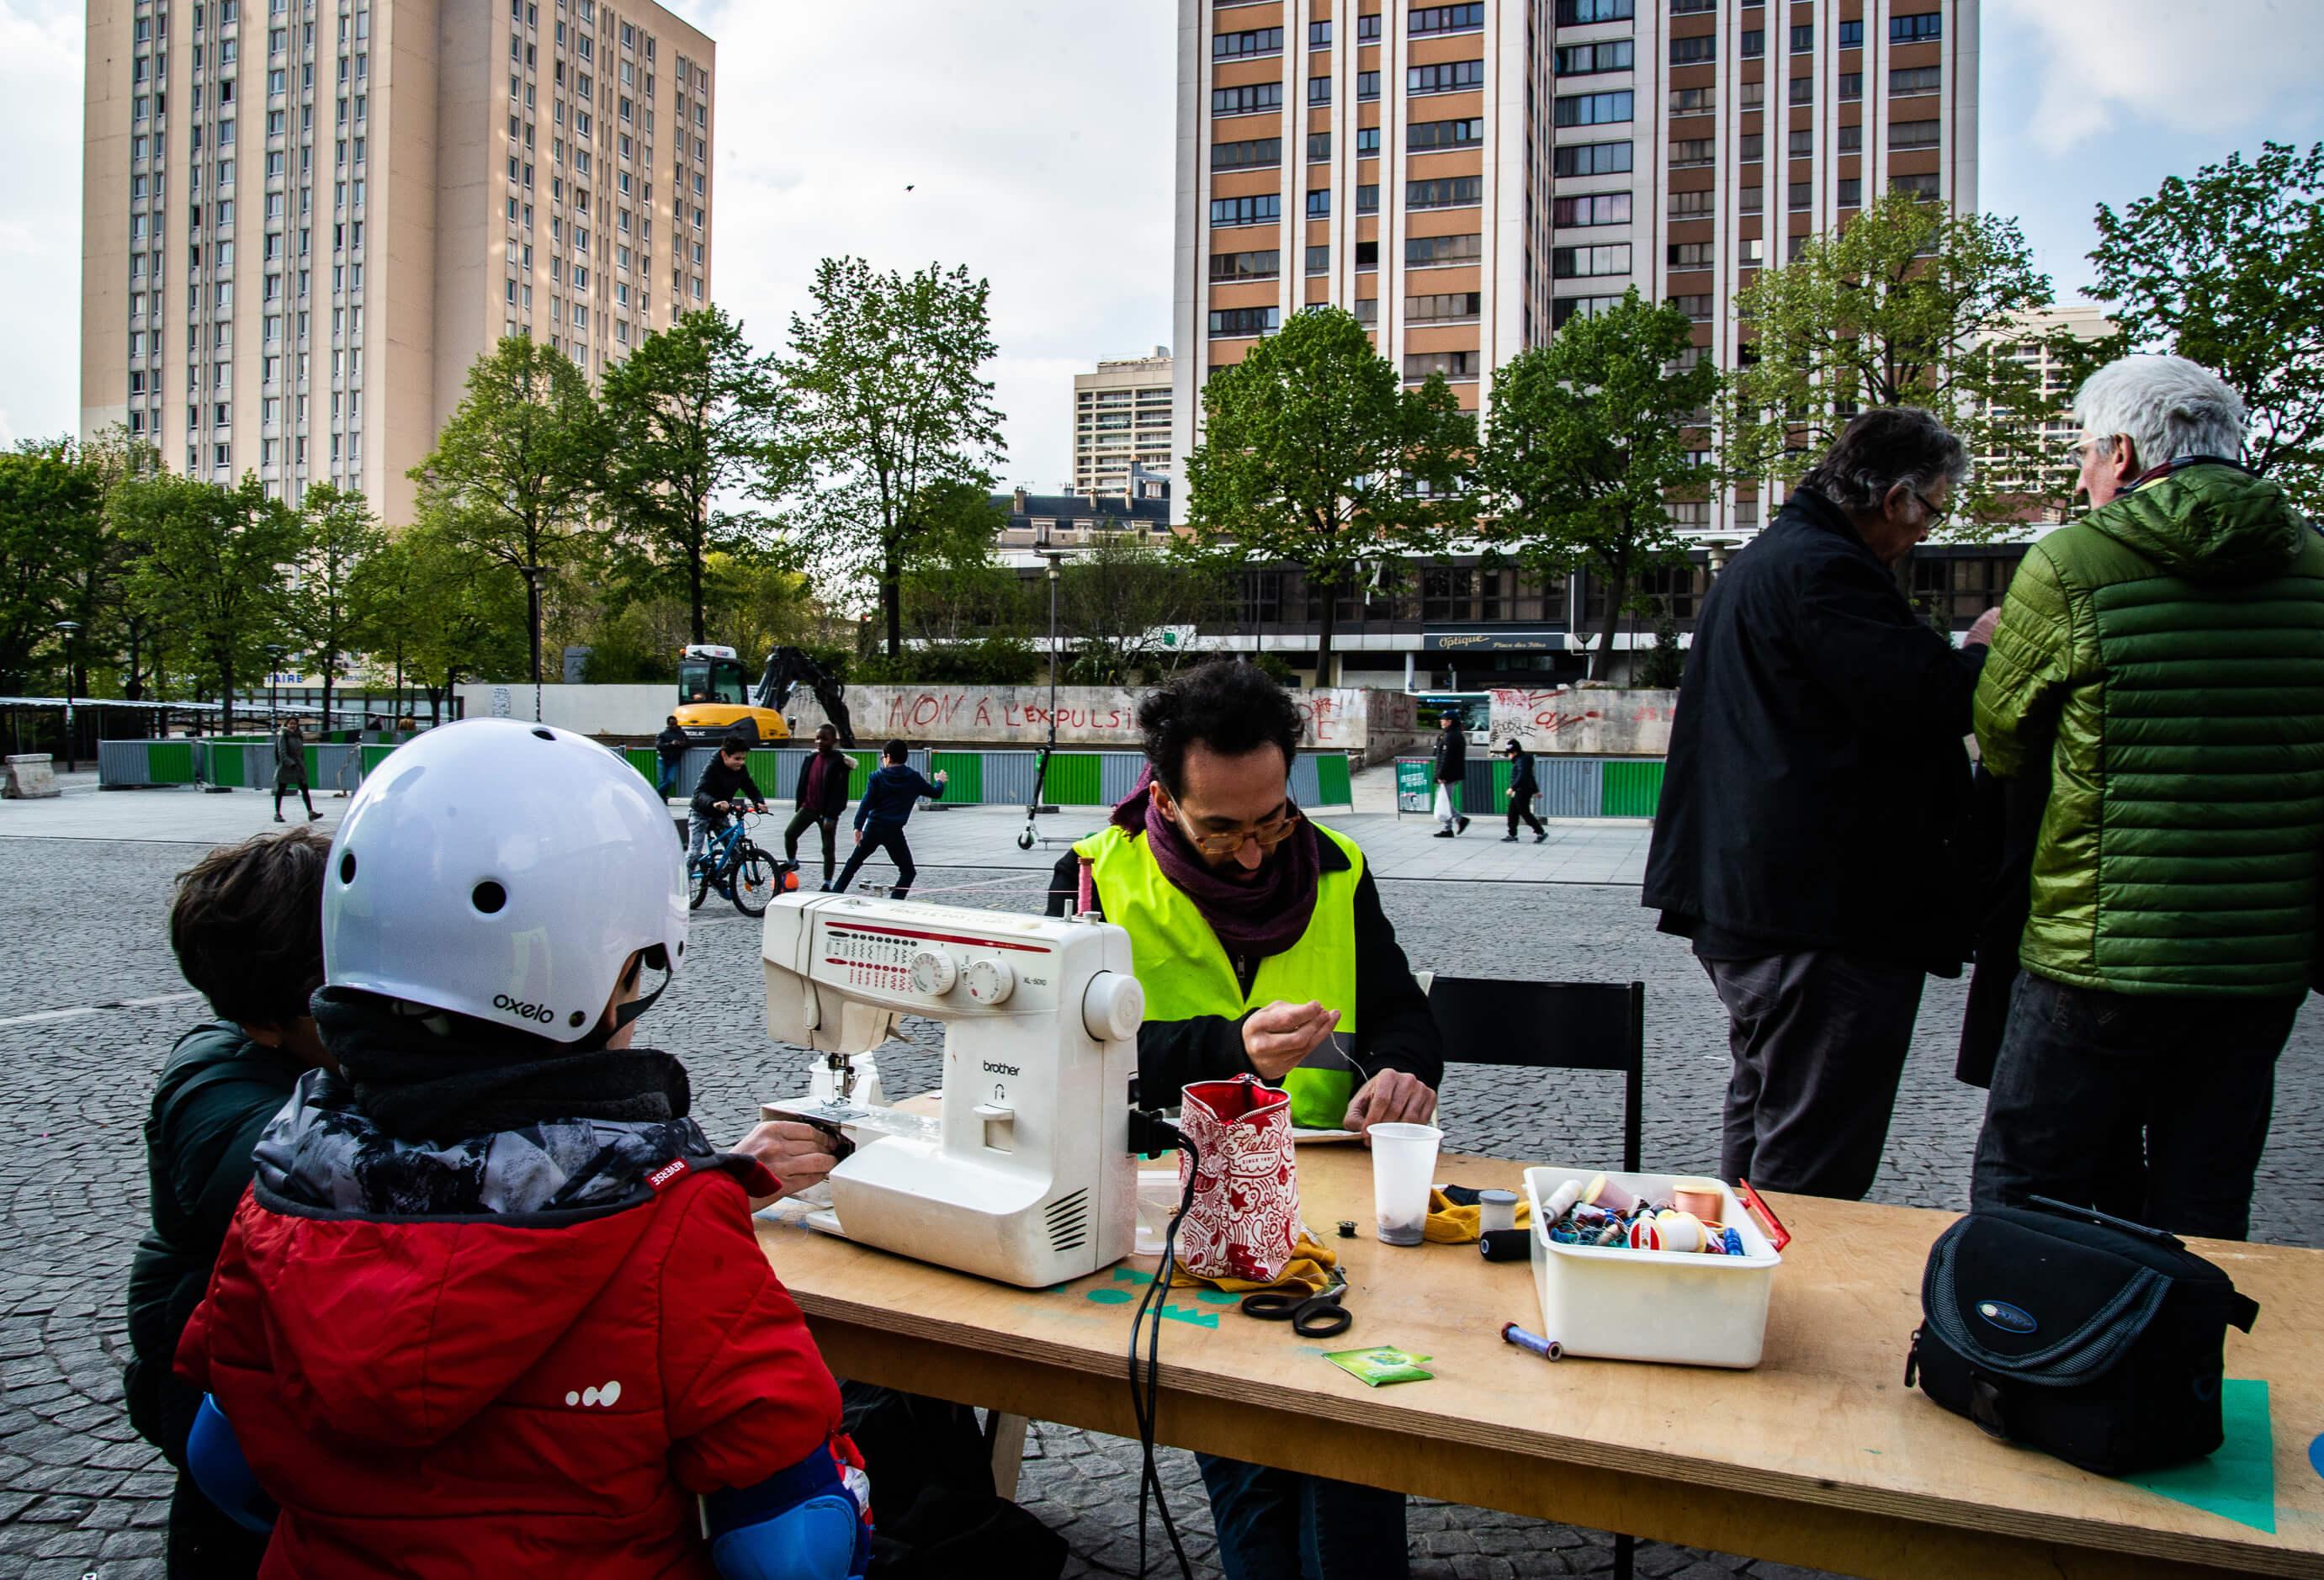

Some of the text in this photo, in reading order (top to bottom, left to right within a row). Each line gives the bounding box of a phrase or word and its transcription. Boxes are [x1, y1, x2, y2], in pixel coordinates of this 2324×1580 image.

[1439, 635, 1489, 649] Optique
[889, 693, 965, 729] NON
[493, 994, 554, 1024] oxelo
[983, 1060, 1021, 1077] brother
[1229, 1133, 1280, 1155] Kiehl's
[650, 1160, 685, 1186] REVERSE
